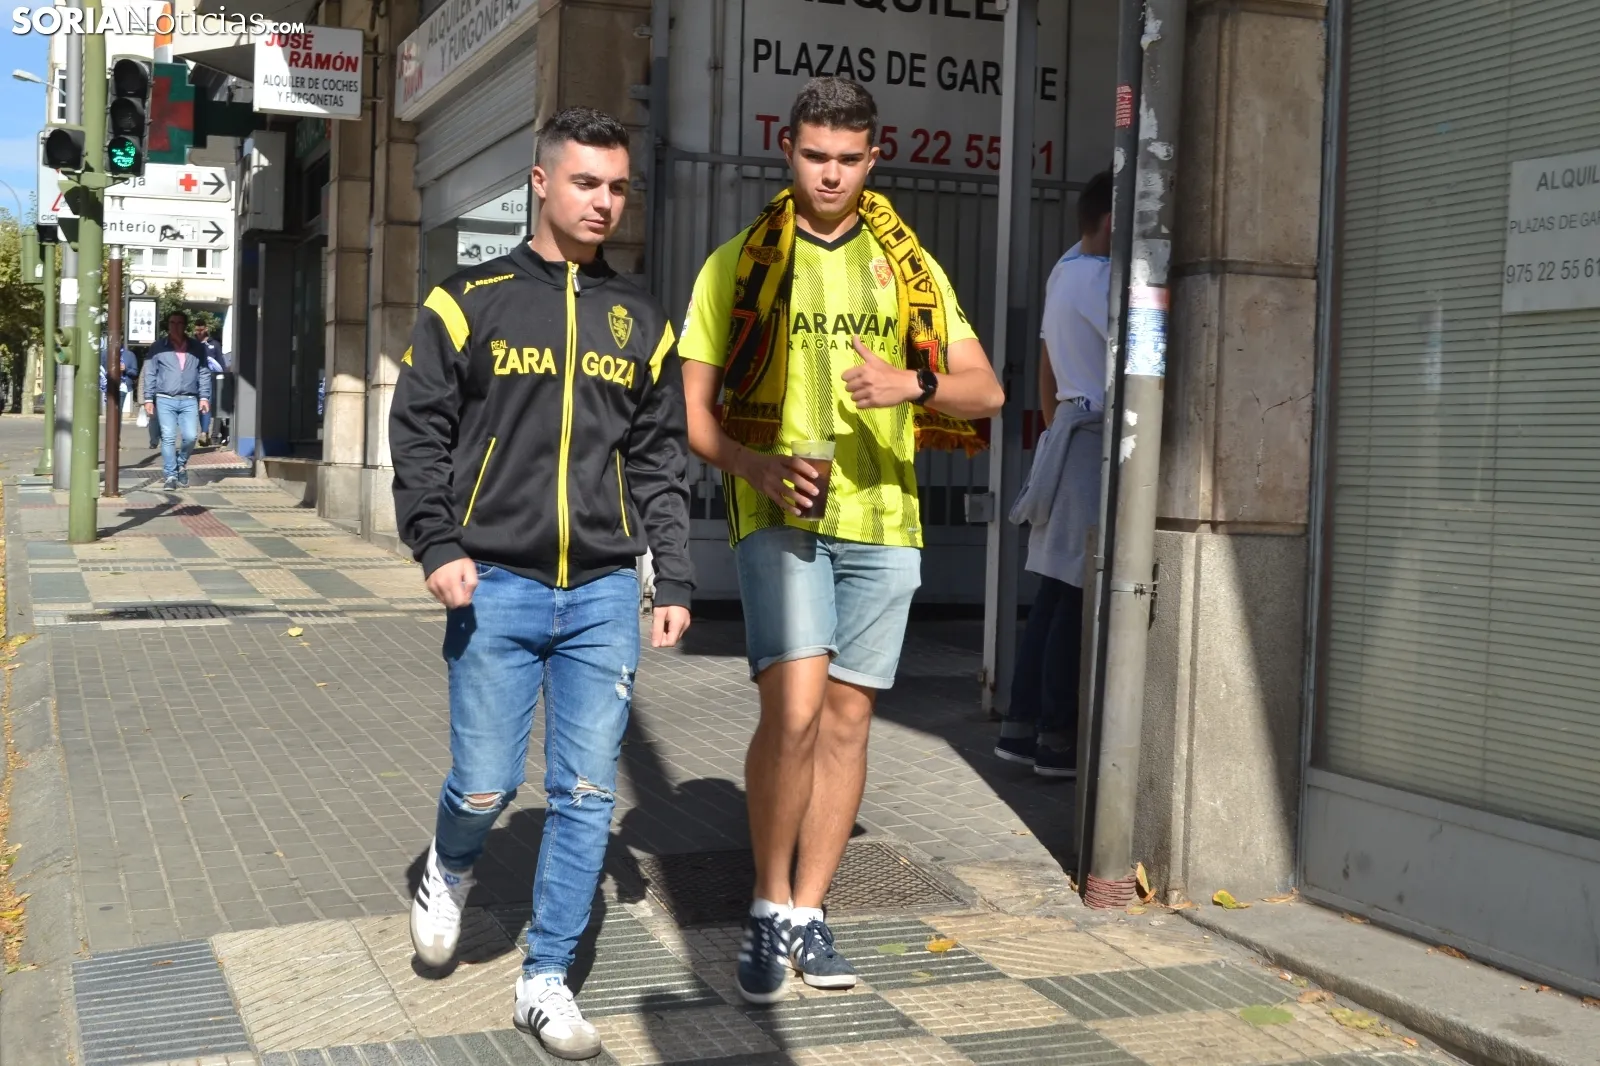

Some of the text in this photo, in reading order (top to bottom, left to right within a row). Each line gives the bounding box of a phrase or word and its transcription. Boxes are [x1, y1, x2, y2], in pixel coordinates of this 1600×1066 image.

[288, 51, 359, 73] RAMÓN
[753, 39, 1057, 101] PLAZAS DE GARE
[263, 74, 358, 92] ALQUILER DE COCHES
[278, 91, 344, 107] Y FURGONETAS
[910, 128, 952, 165] 22
[964, 134, 1001, 170] 55
[1536, 165, 1600, 192] ALQUIL
[1510, 216, 1555, 234] PLAZAS
[1558, 214, 1577, 229] DE
[475, 274, 515, 286] MERCURY
[1506, 264, 1533, 284] 975
[1538, 262, 1556, 281] 22
[1561, 259, 1580, 280] 55
[491, 340, 509, 349] REAL
[787, 338, 898, 355] RAGANIAS
[493, 348, 636, 389] ZARA GOZA
